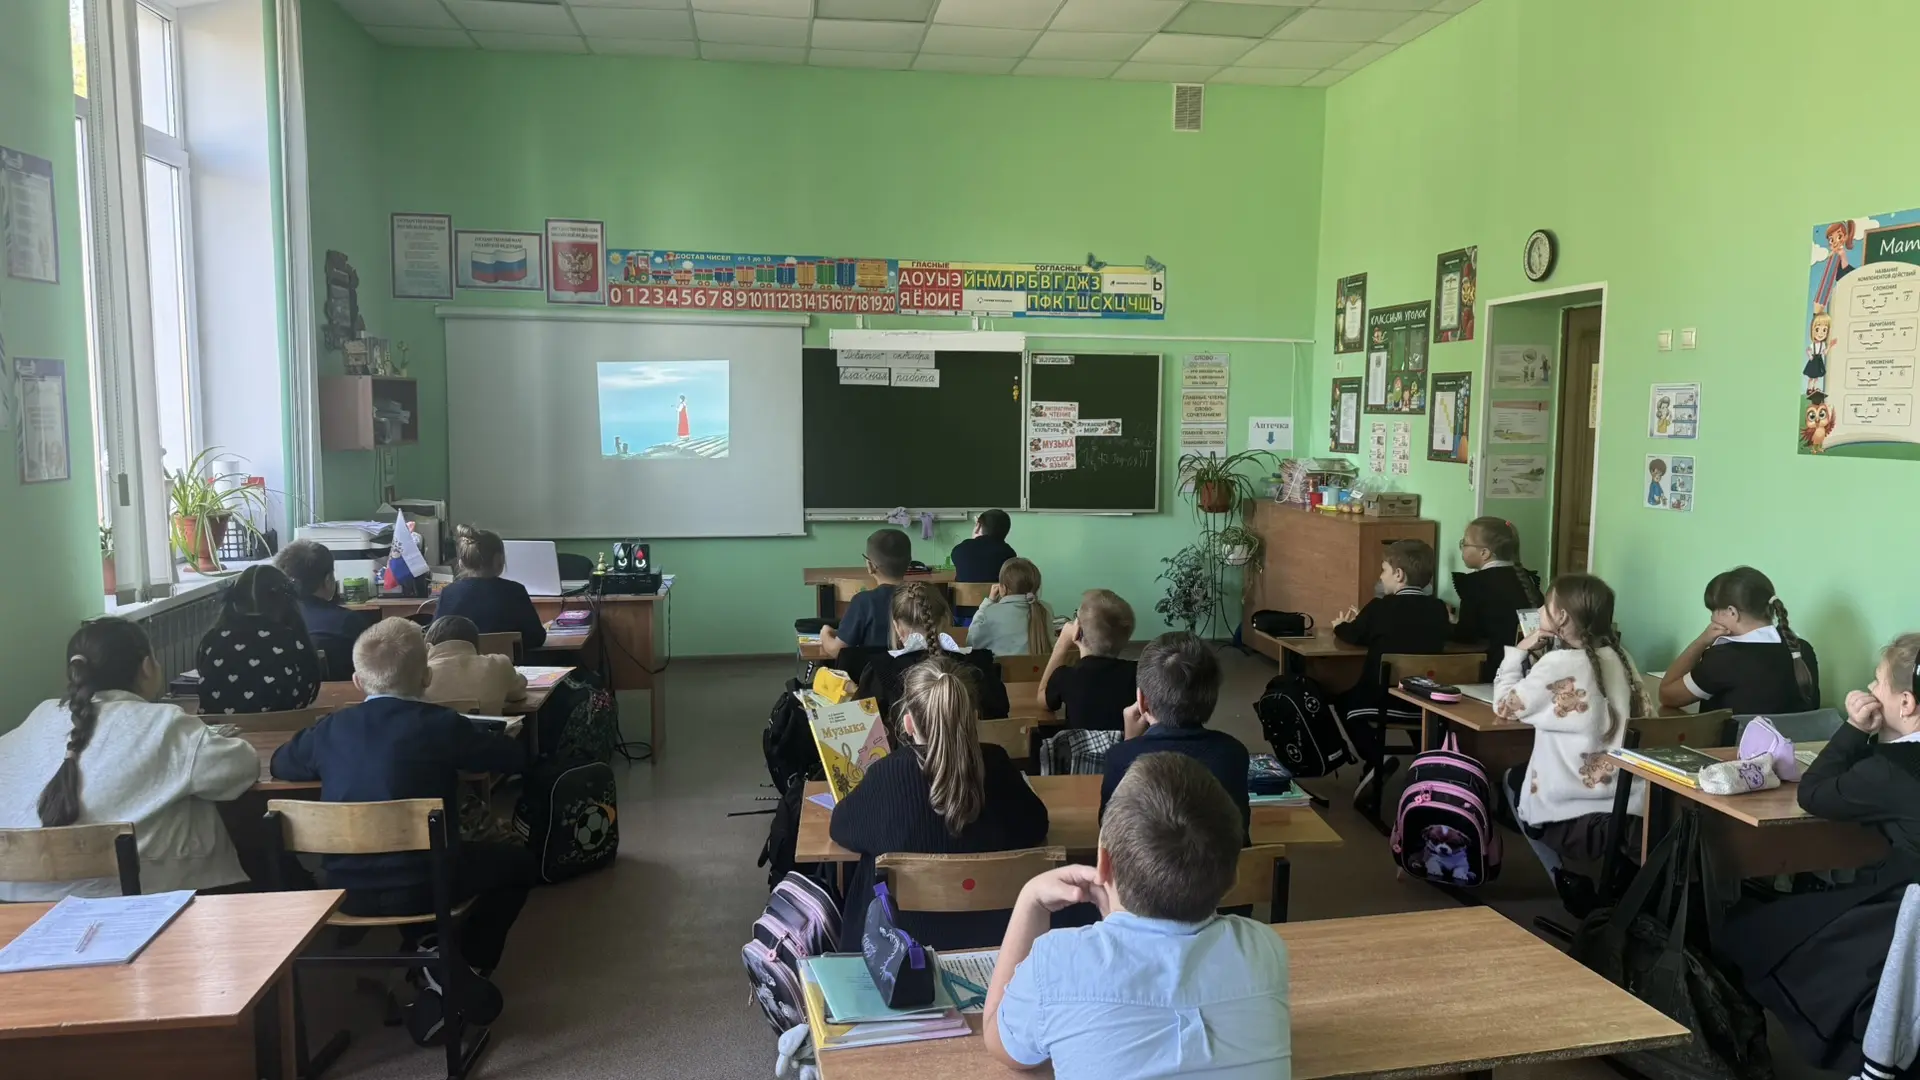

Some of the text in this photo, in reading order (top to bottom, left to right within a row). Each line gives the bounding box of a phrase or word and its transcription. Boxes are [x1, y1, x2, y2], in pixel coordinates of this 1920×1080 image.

[675, 253, 705, 261] СОСТАВ
[706, 254, 731, 262] ЧИСЕЛ
[911, 261, 950, 269] ГЛАСНЫЕ
[1034, 264, 1083, 272] СОГЛАСНЫЕ
[1370, 307, 1428, 325] КЛАССНЫЙ УГОЛОК
[840, 367, 936, 385] Классная работа
[1042, 439, 1074, 448] МУЗЫКА
[821, 722, 867, 739] Музыка
